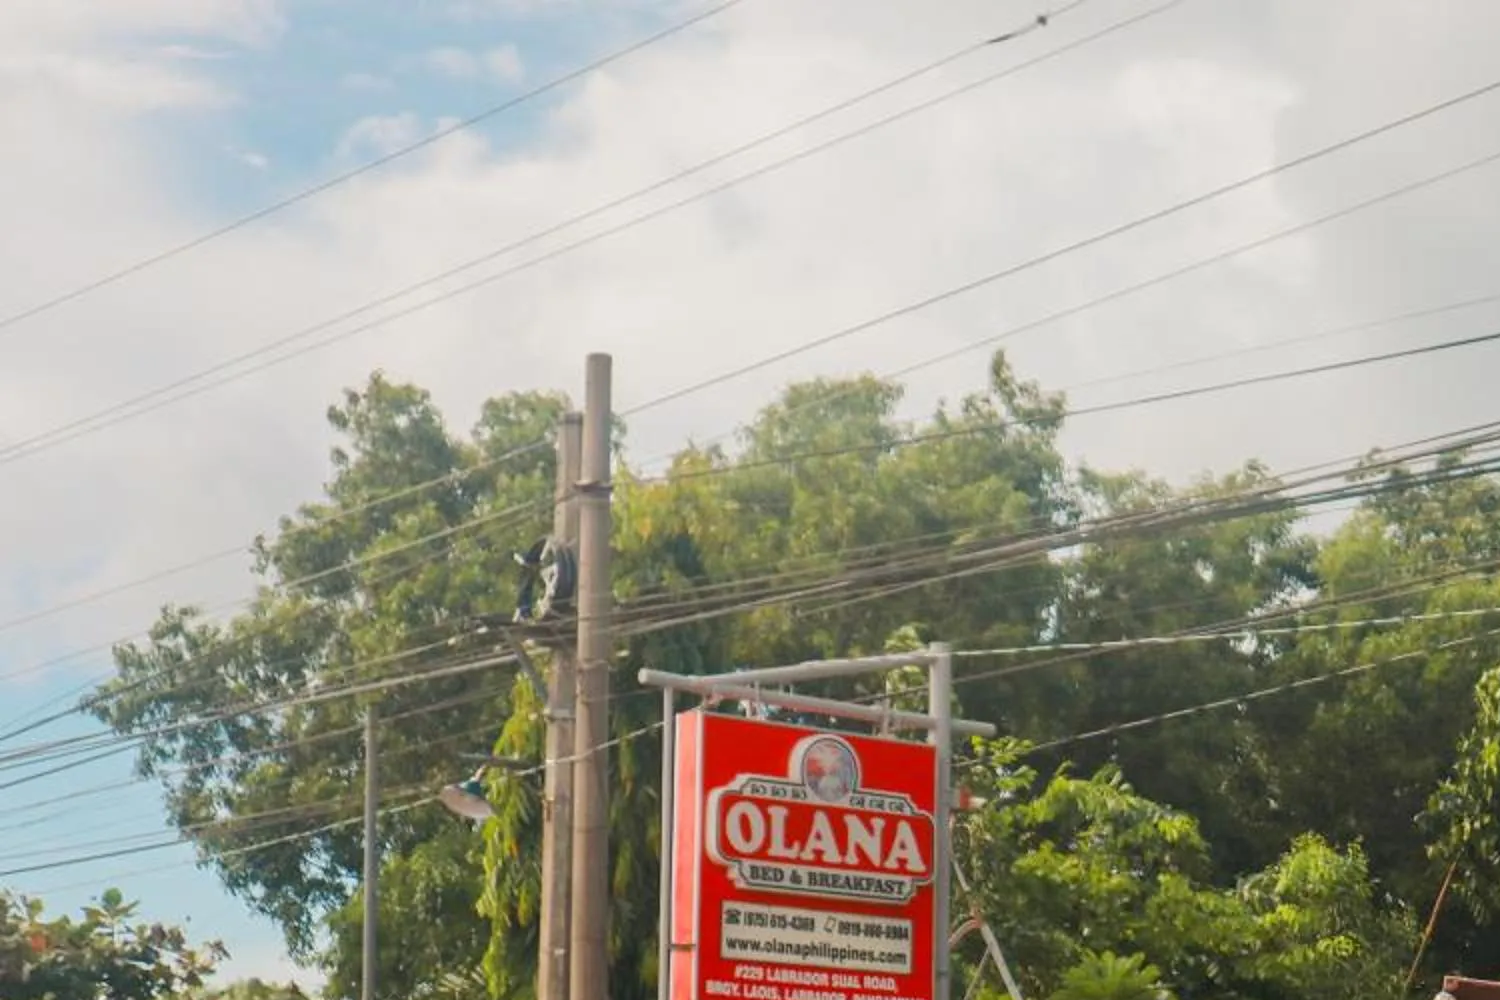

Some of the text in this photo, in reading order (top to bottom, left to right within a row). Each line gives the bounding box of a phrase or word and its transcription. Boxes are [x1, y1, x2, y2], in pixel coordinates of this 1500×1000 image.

[725, 801, 926, 872] OLANA
[750, 865, 907, 894] BED & BREAKFAST
[725, 936, 907, 965] www.olanaphilippines.com
[766, 967, 829, 987] LABRADOR
